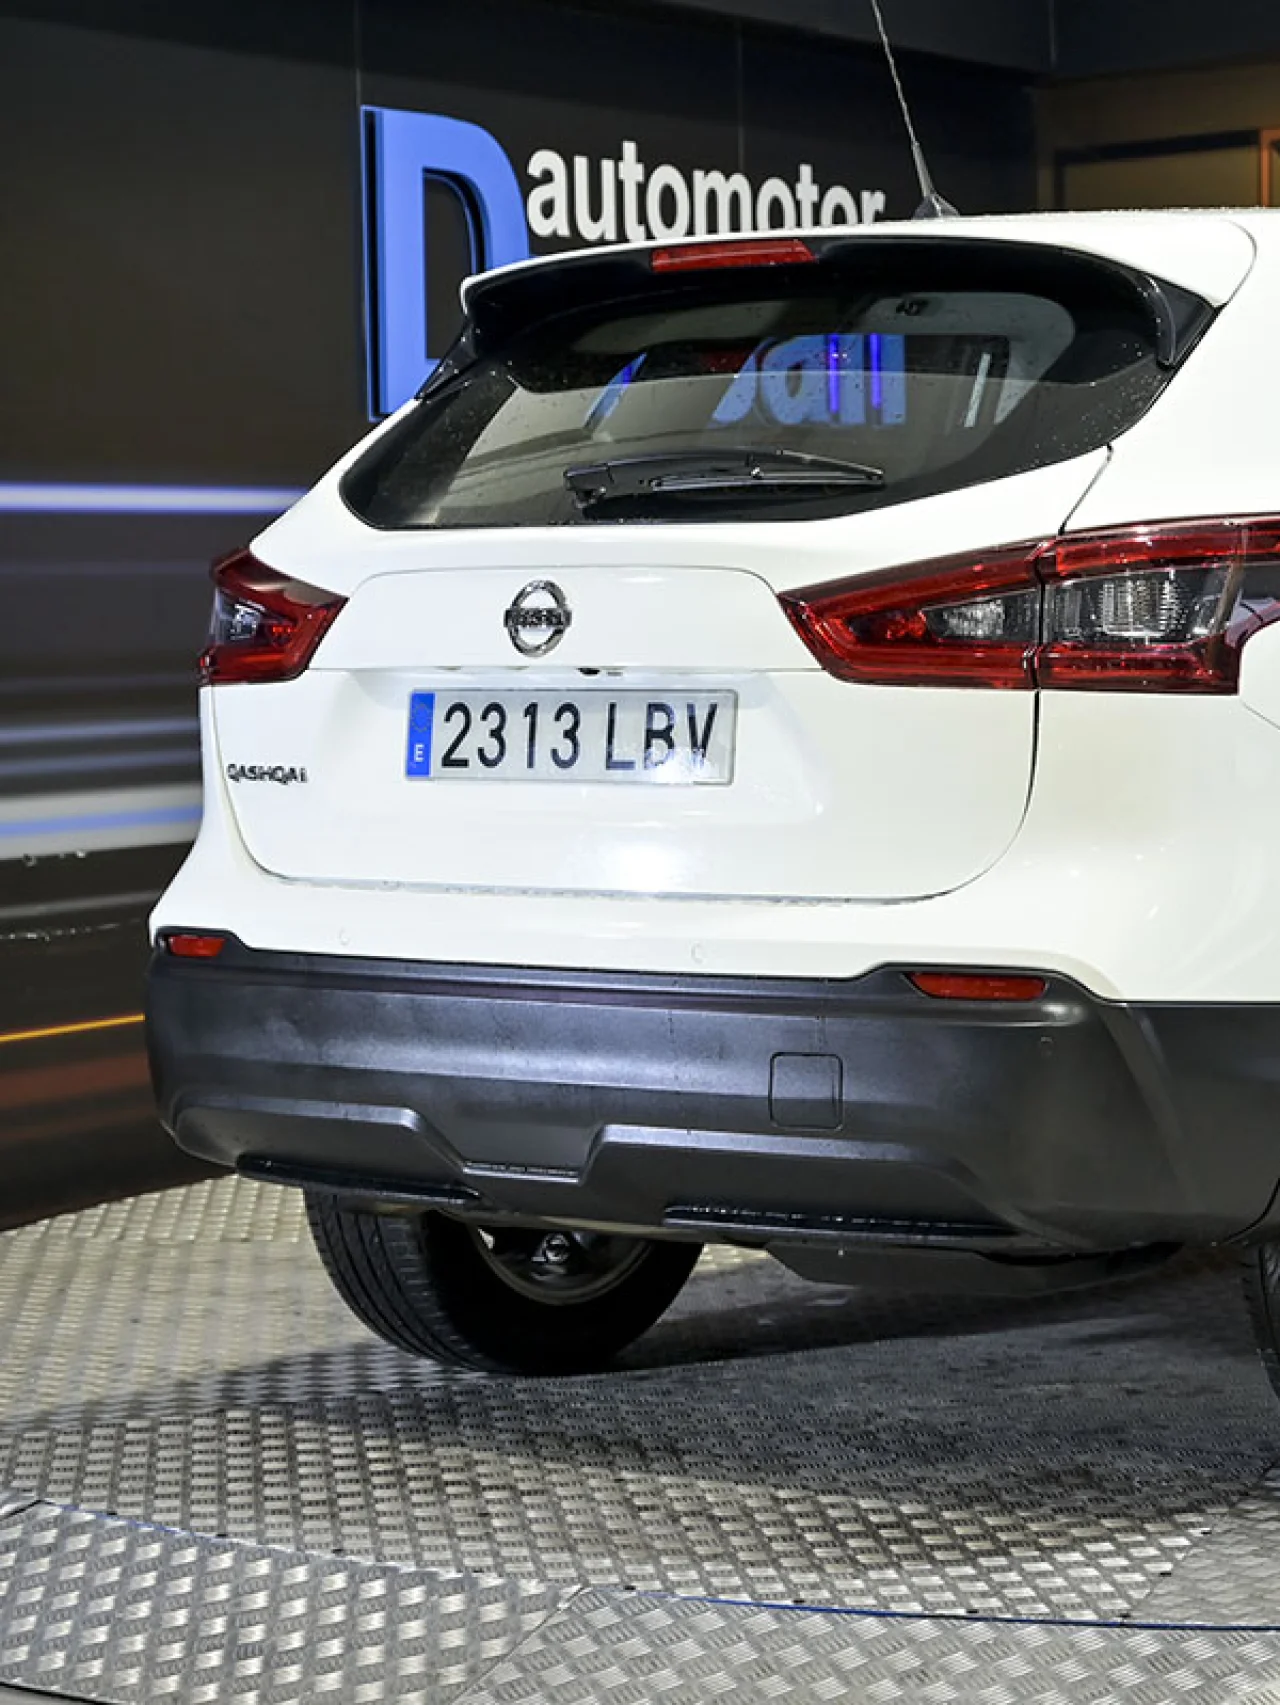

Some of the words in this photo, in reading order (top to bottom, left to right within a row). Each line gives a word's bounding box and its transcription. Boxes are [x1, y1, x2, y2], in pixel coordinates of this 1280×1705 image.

[526, 140, 887, 241] automotor
[413, 743, 425, 762] E
[441, 701, 580, 769] 2313
[605, 701, 718, 771] LBV
